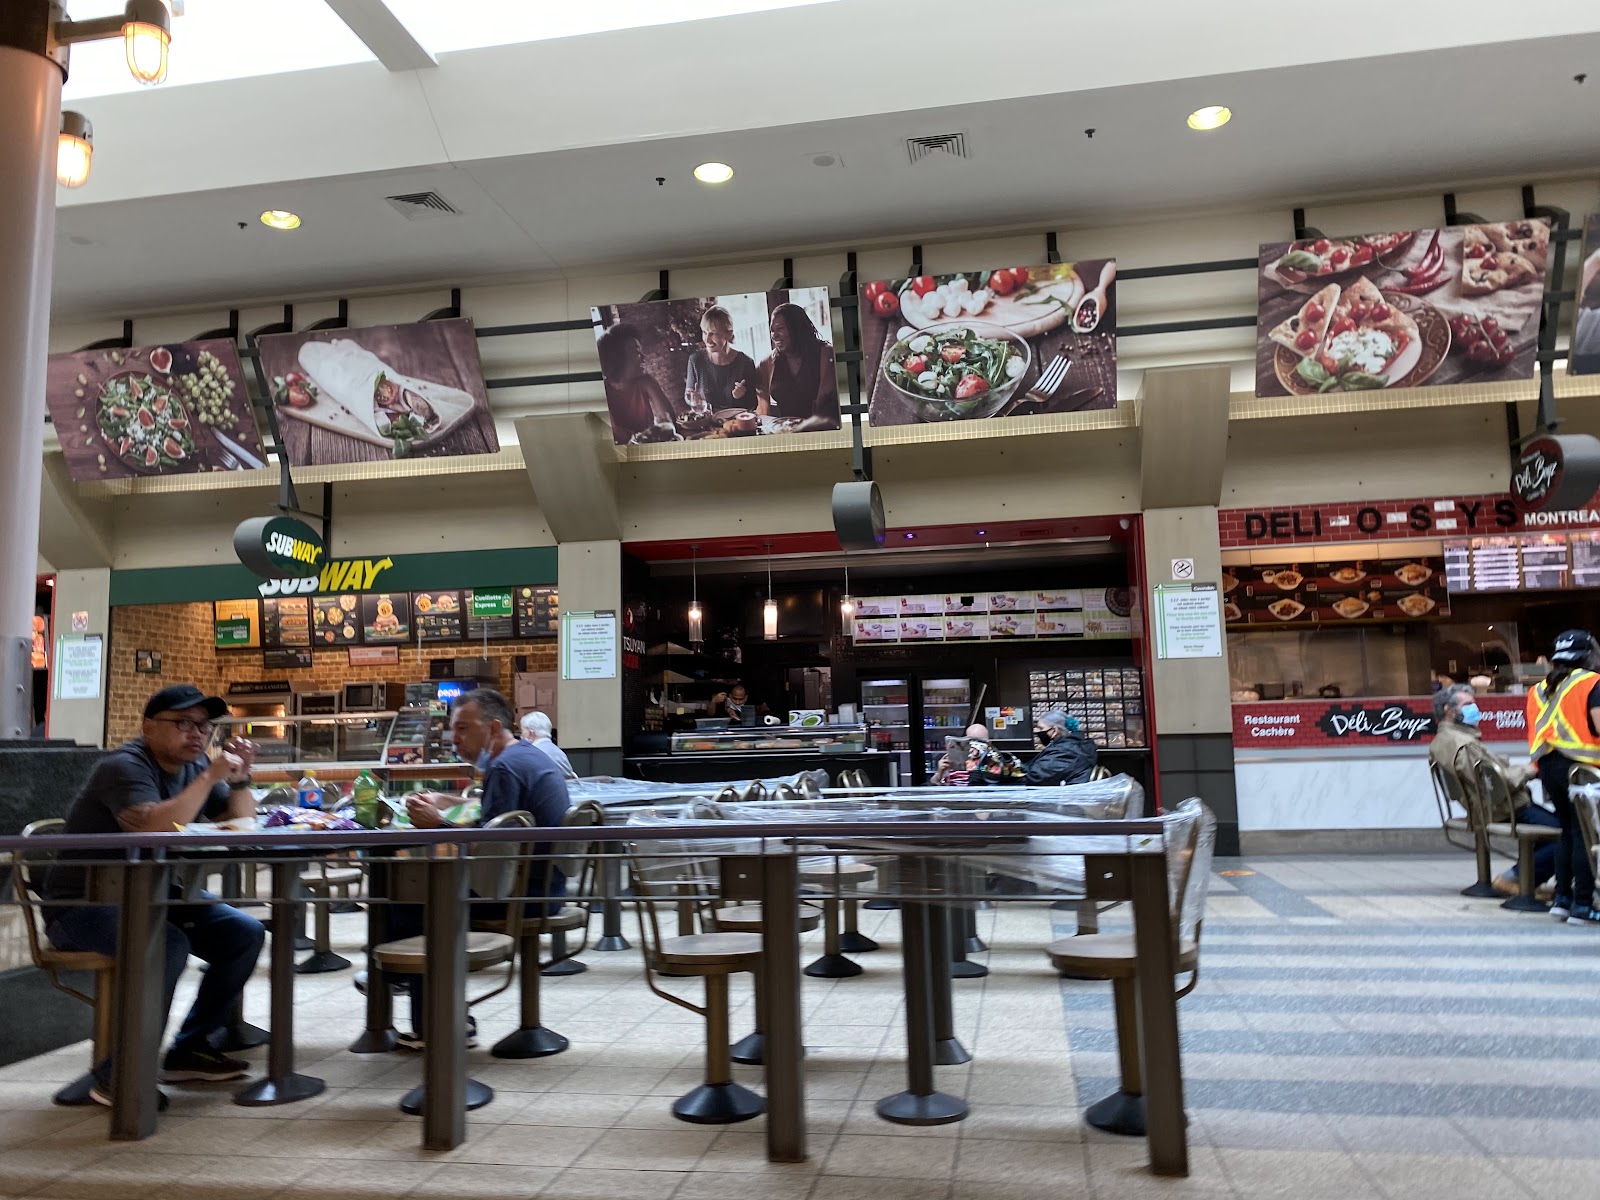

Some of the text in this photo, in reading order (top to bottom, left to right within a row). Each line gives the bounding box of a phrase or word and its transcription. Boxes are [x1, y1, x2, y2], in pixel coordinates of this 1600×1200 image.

[1245, 510, 1322, 540] DELI
[265, 531, 323, 564] SUBWAY
[437, 688, 461, 698] pepsi
[1244, 713, 1300, 726] Restaurant
[1329, 706, 1432, 740] Déli Boyz
[1251, 726, 1295, 738] Cachère
